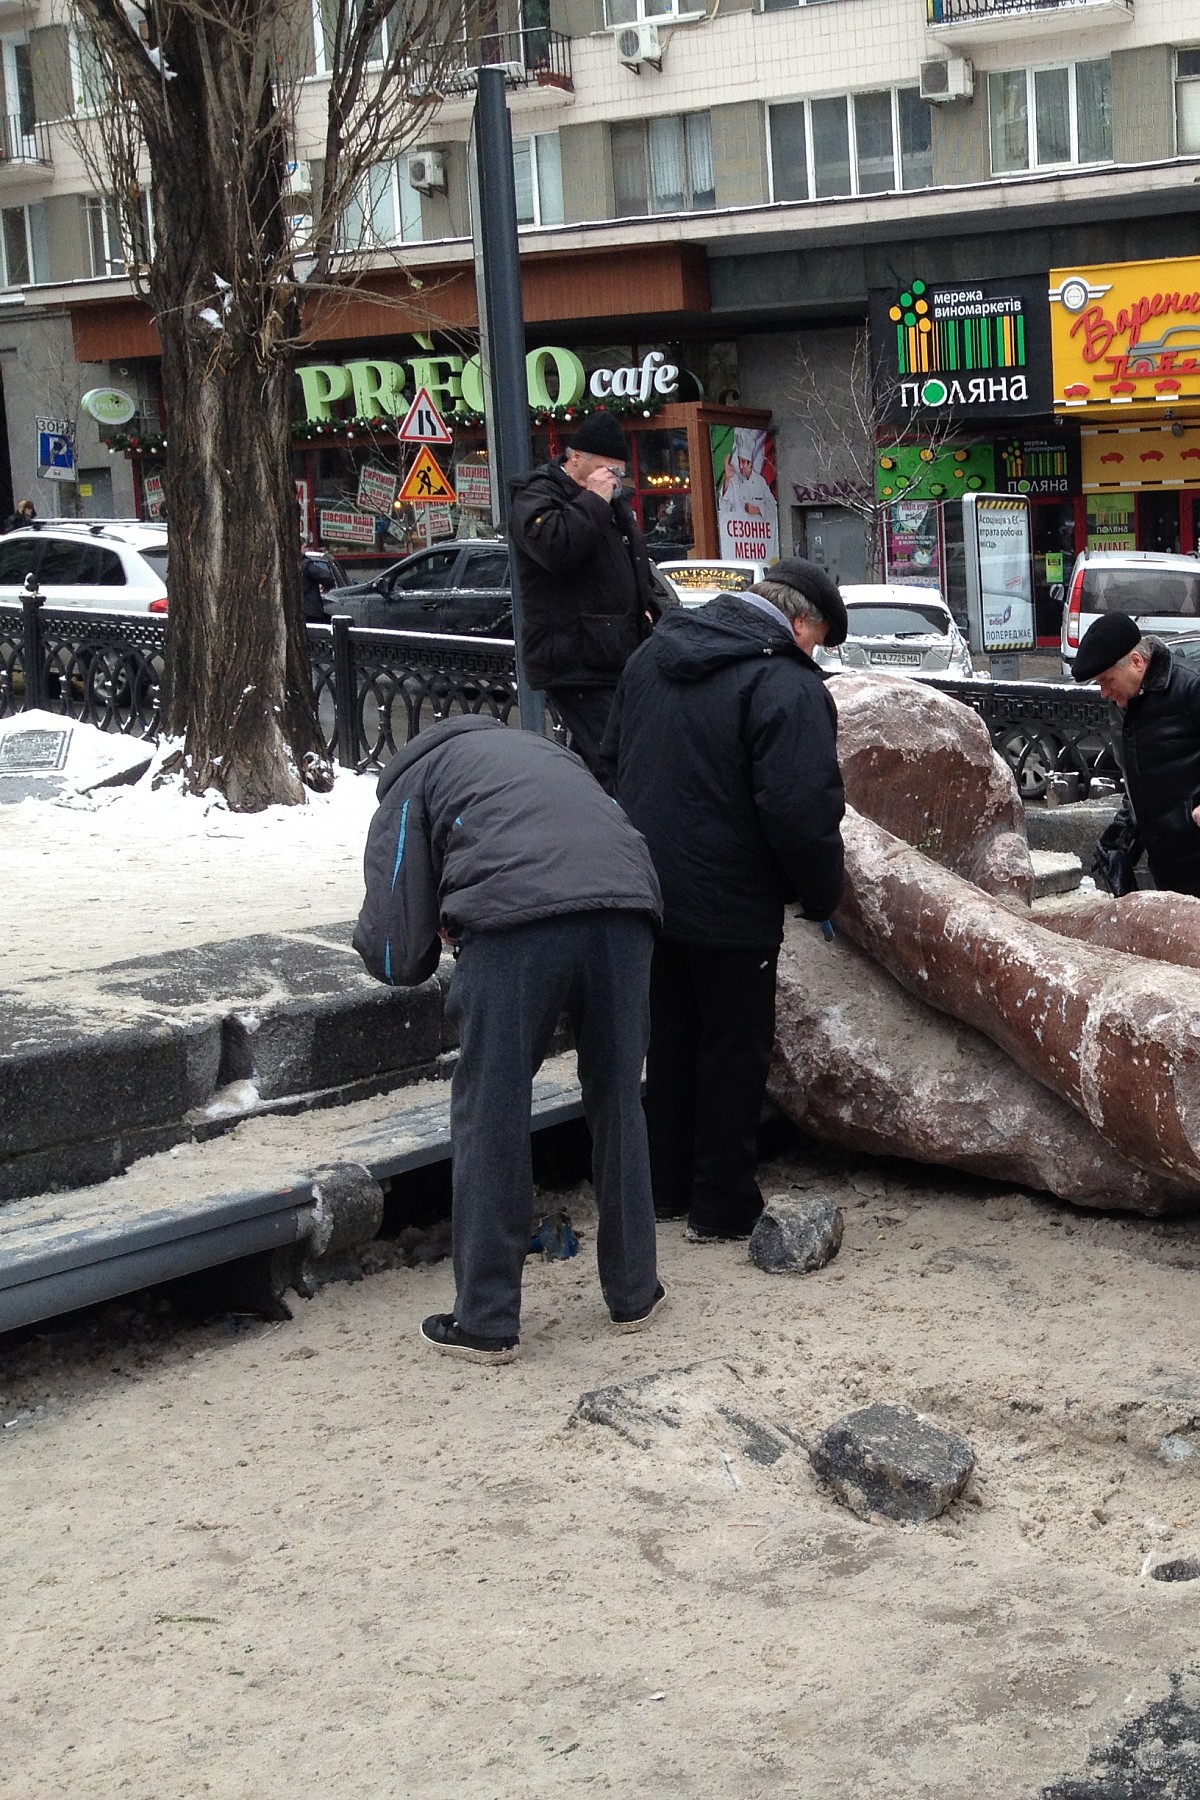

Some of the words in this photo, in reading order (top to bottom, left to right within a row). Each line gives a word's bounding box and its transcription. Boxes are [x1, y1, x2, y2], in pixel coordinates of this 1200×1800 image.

[933, 290, 983, 306] мережа
[934, 298, 1022, 318] виномаркетів
[589, 351, 680, 403] cafe
[726, 519, 771, 539] СЕЗОННЕ
[735, 541, 767, 560] МЕНЮ
[986, 629, 1032, 641] ПОПЕРЕДЖАЄ
